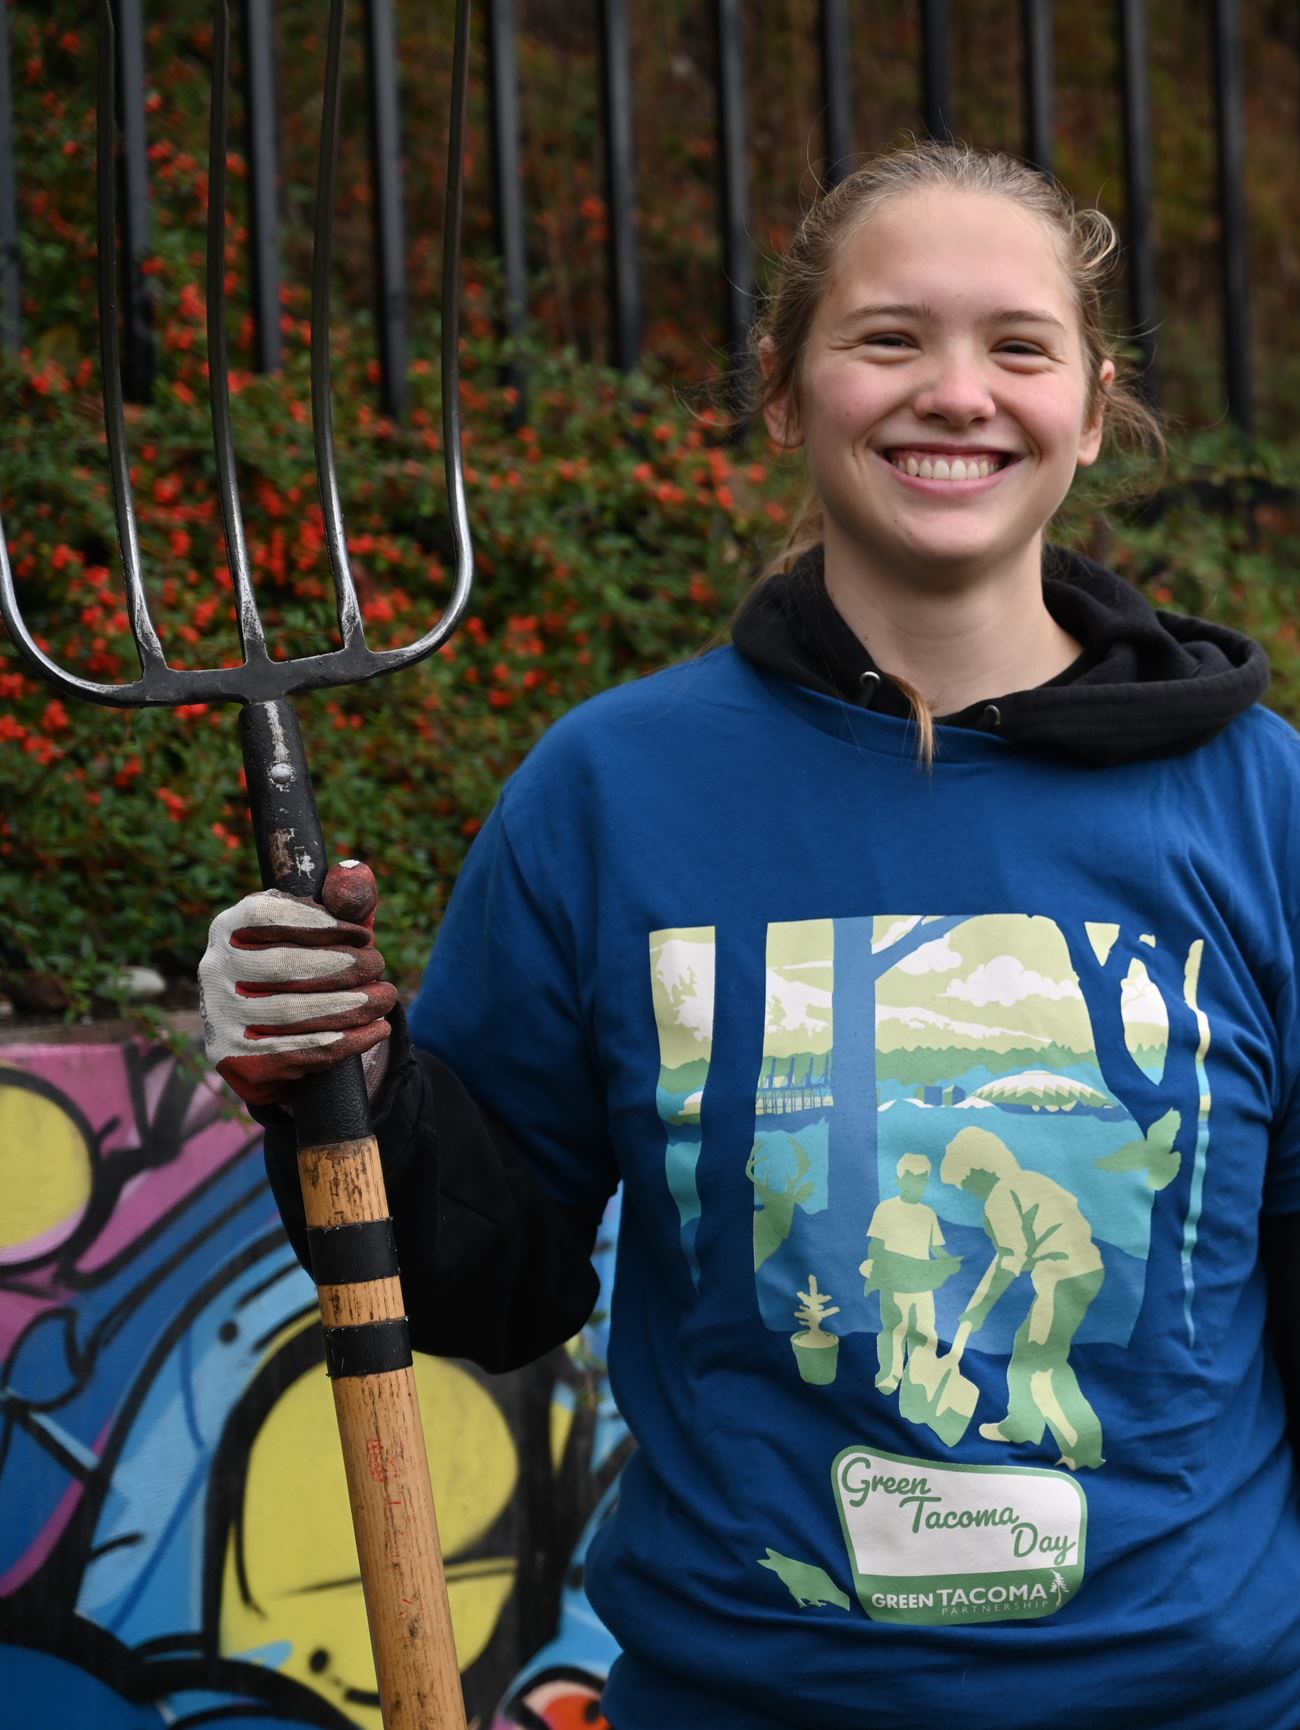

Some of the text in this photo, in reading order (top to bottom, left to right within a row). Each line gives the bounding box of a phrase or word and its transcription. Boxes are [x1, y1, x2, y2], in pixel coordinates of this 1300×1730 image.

[841, 1457, 931, 1508] Green
[899, 1496, 1019, 1534] Tacoma
[1011, 1522, 1077, 1566] Day
[871, 1583, 1048, 1609] GREEN TACOMA
[942, 1600, 1049, 1616] PARTNERSHIP
